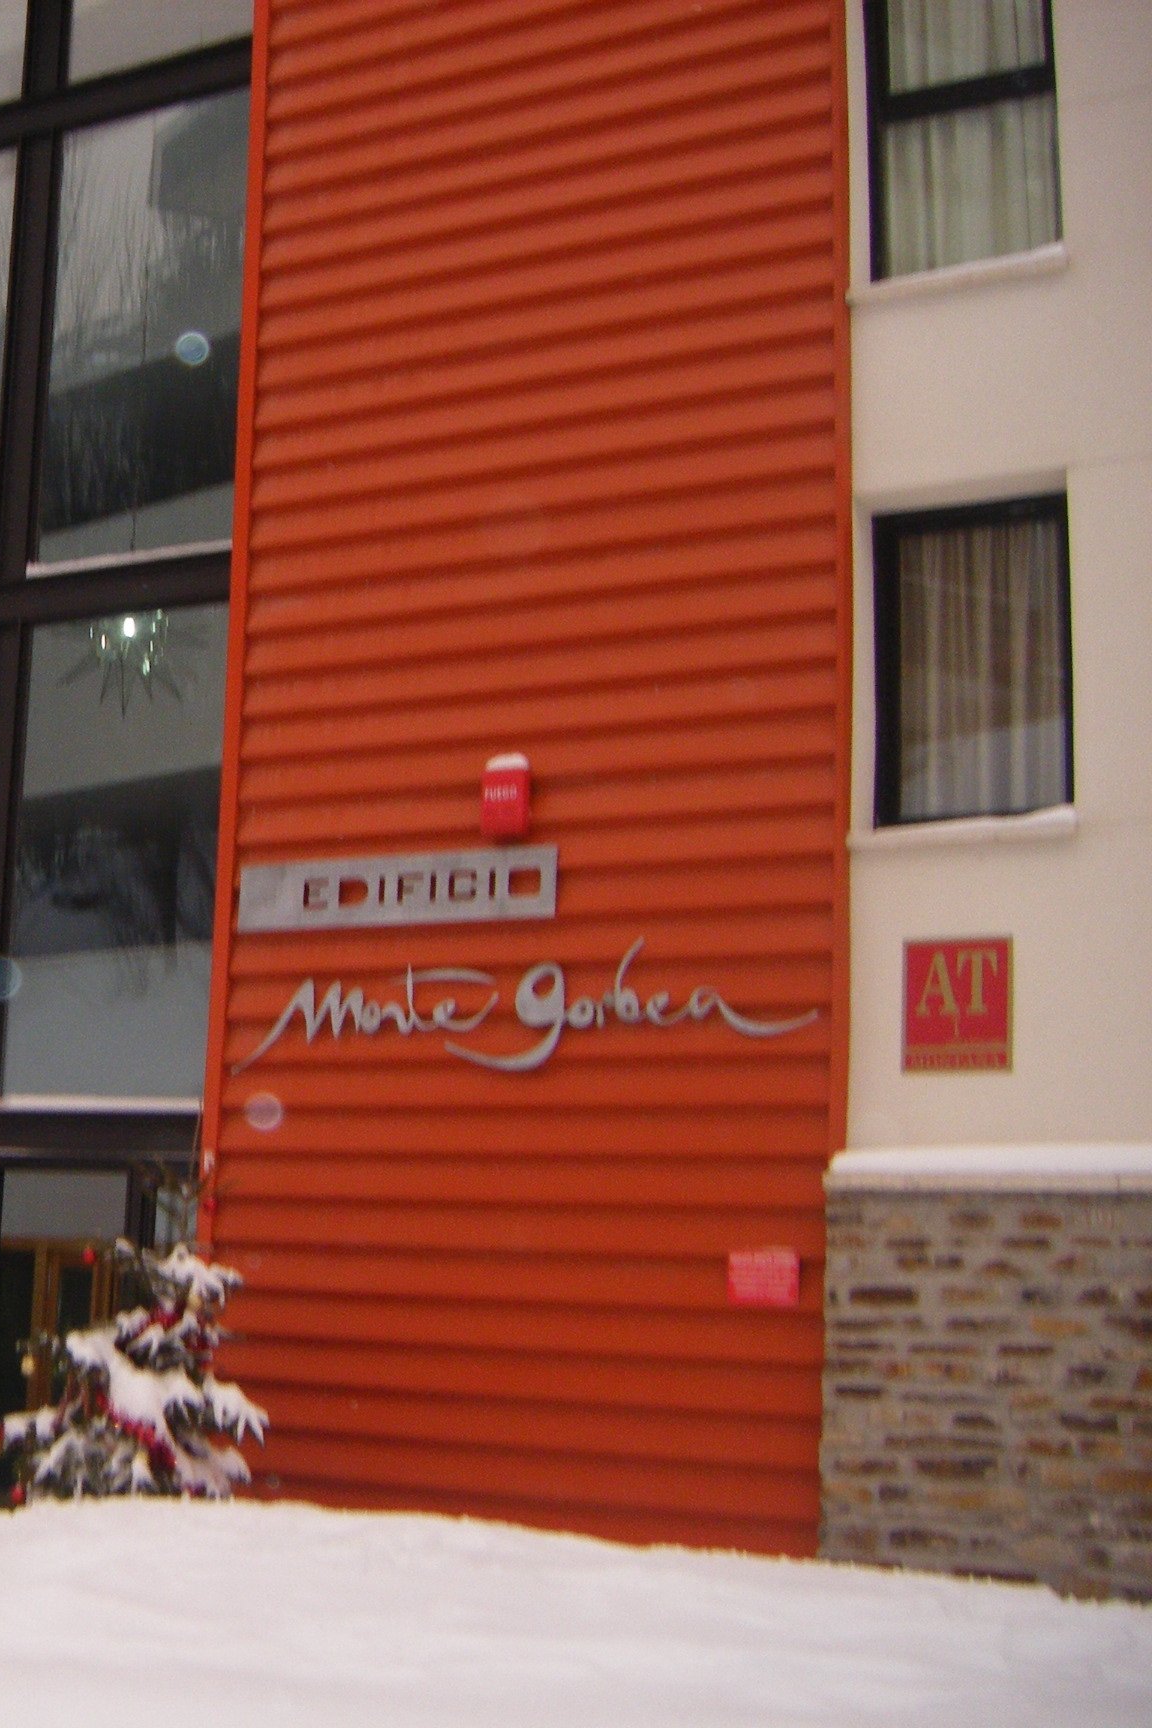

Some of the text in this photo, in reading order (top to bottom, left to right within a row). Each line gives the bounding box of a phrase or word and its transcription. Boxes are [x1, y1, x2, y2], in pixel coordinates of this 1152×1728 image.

[302, 866, 542, 911] EDIFICIO
[915, 950, 998, 1017] AT
[231, 962, 499, 1076] Monte
